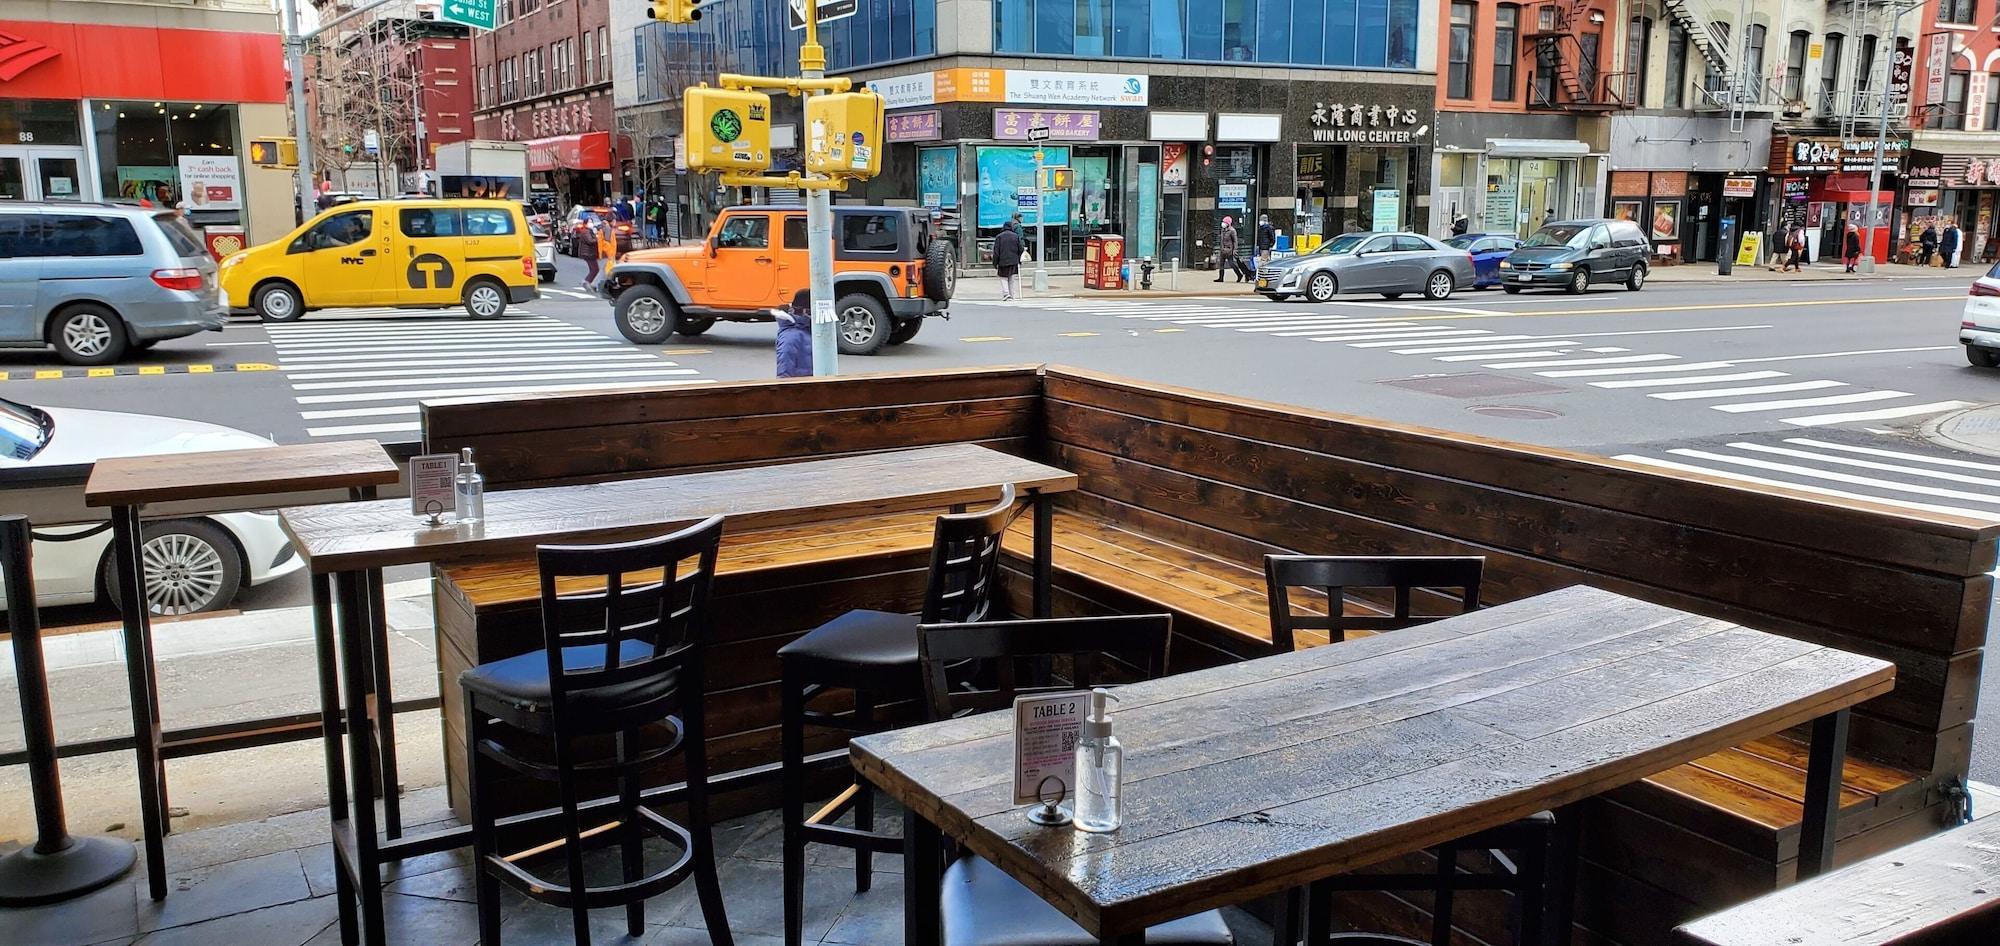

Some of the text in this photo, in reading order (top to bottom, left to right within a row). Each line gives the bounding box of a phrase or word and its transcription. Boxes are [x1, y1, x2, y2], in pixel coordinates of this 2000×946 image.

[467, 7, 490, 21] WEST
[1030, 79, 1099, 91] 雙文教育系統
[1010, 91, 1021, 99] The
[1023, 92, 1047, 101] Shuang
[1062, 94, 1090, 103] Academy
[1310, 102, 1418, 127] 永隆商業中心
[19, 132, 34, 142] 88
[1313, 130, 1410, 143] WIN LONG CENTER
[1529, 163, 1539, 171] 94
[341, 257, 364, 265] NYC
[416, 262, 443, 288] T
[1103, 266, 1120, 276] LOVE
[422, 461, 444, 470] TABLE
[1034, 702, 1076, 718] TABLE 2
